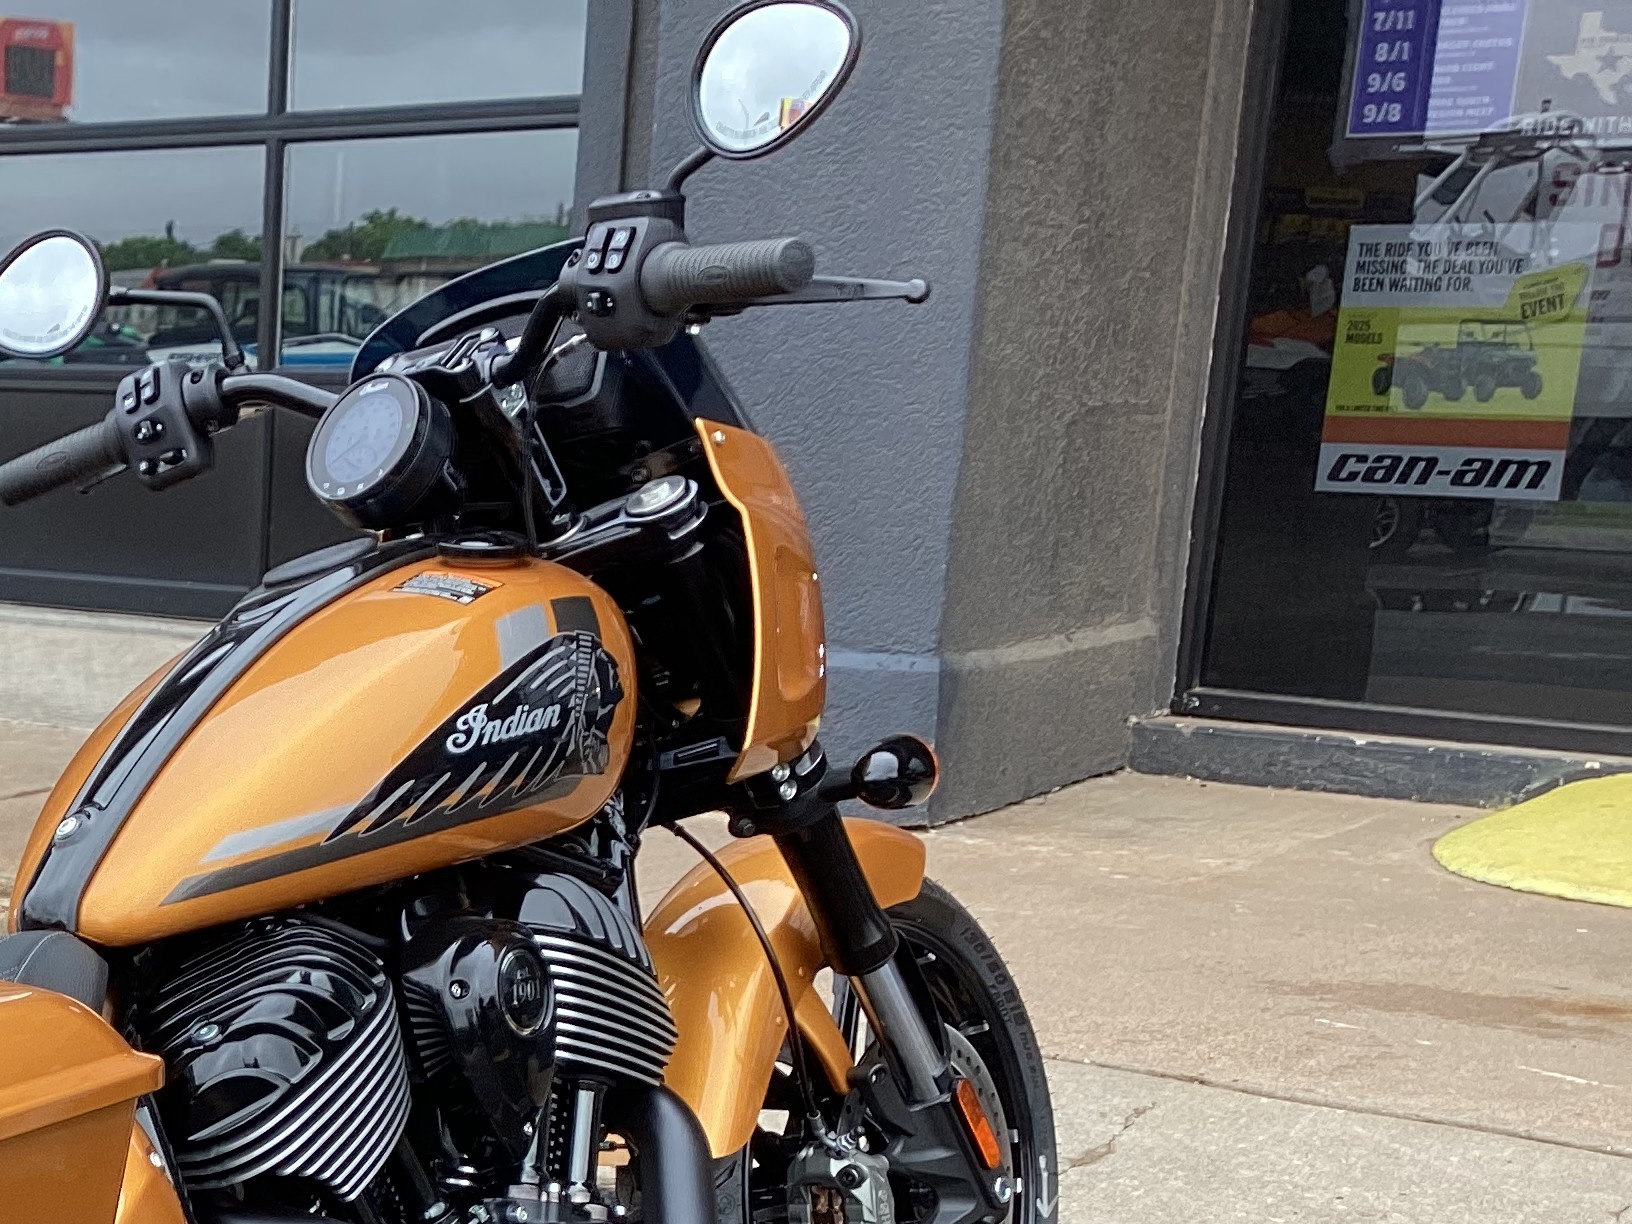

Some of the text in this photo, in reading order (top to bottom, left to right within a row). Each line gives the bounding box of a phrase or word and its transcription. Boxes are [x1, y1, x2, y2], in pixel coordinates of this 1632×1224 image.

[1372, 9, 1415, 32] 7/11
[1373, 40, 1411, 62] 8/1
[1366, 72, 1406, 94] 9/6
[1361, 103, 1402, 124] 9/8
[1357, 242, 1381, 258] THE
[1384, 242, 1414, 258] RIDE
[1443, 259, 1475, 275] DEAL
[1478, 258, 1525, 275] YOU'VE
[1352, 276, 1385, 292] BEEN
[1388, 276, 1443, 292] WAITING
[1520, 293, 1565, 320] EVENT
[1326, 452, 1552, 490] can-am
[445, 702, 563, 754] Indian
[512, 978, 541, 1008] 1901
